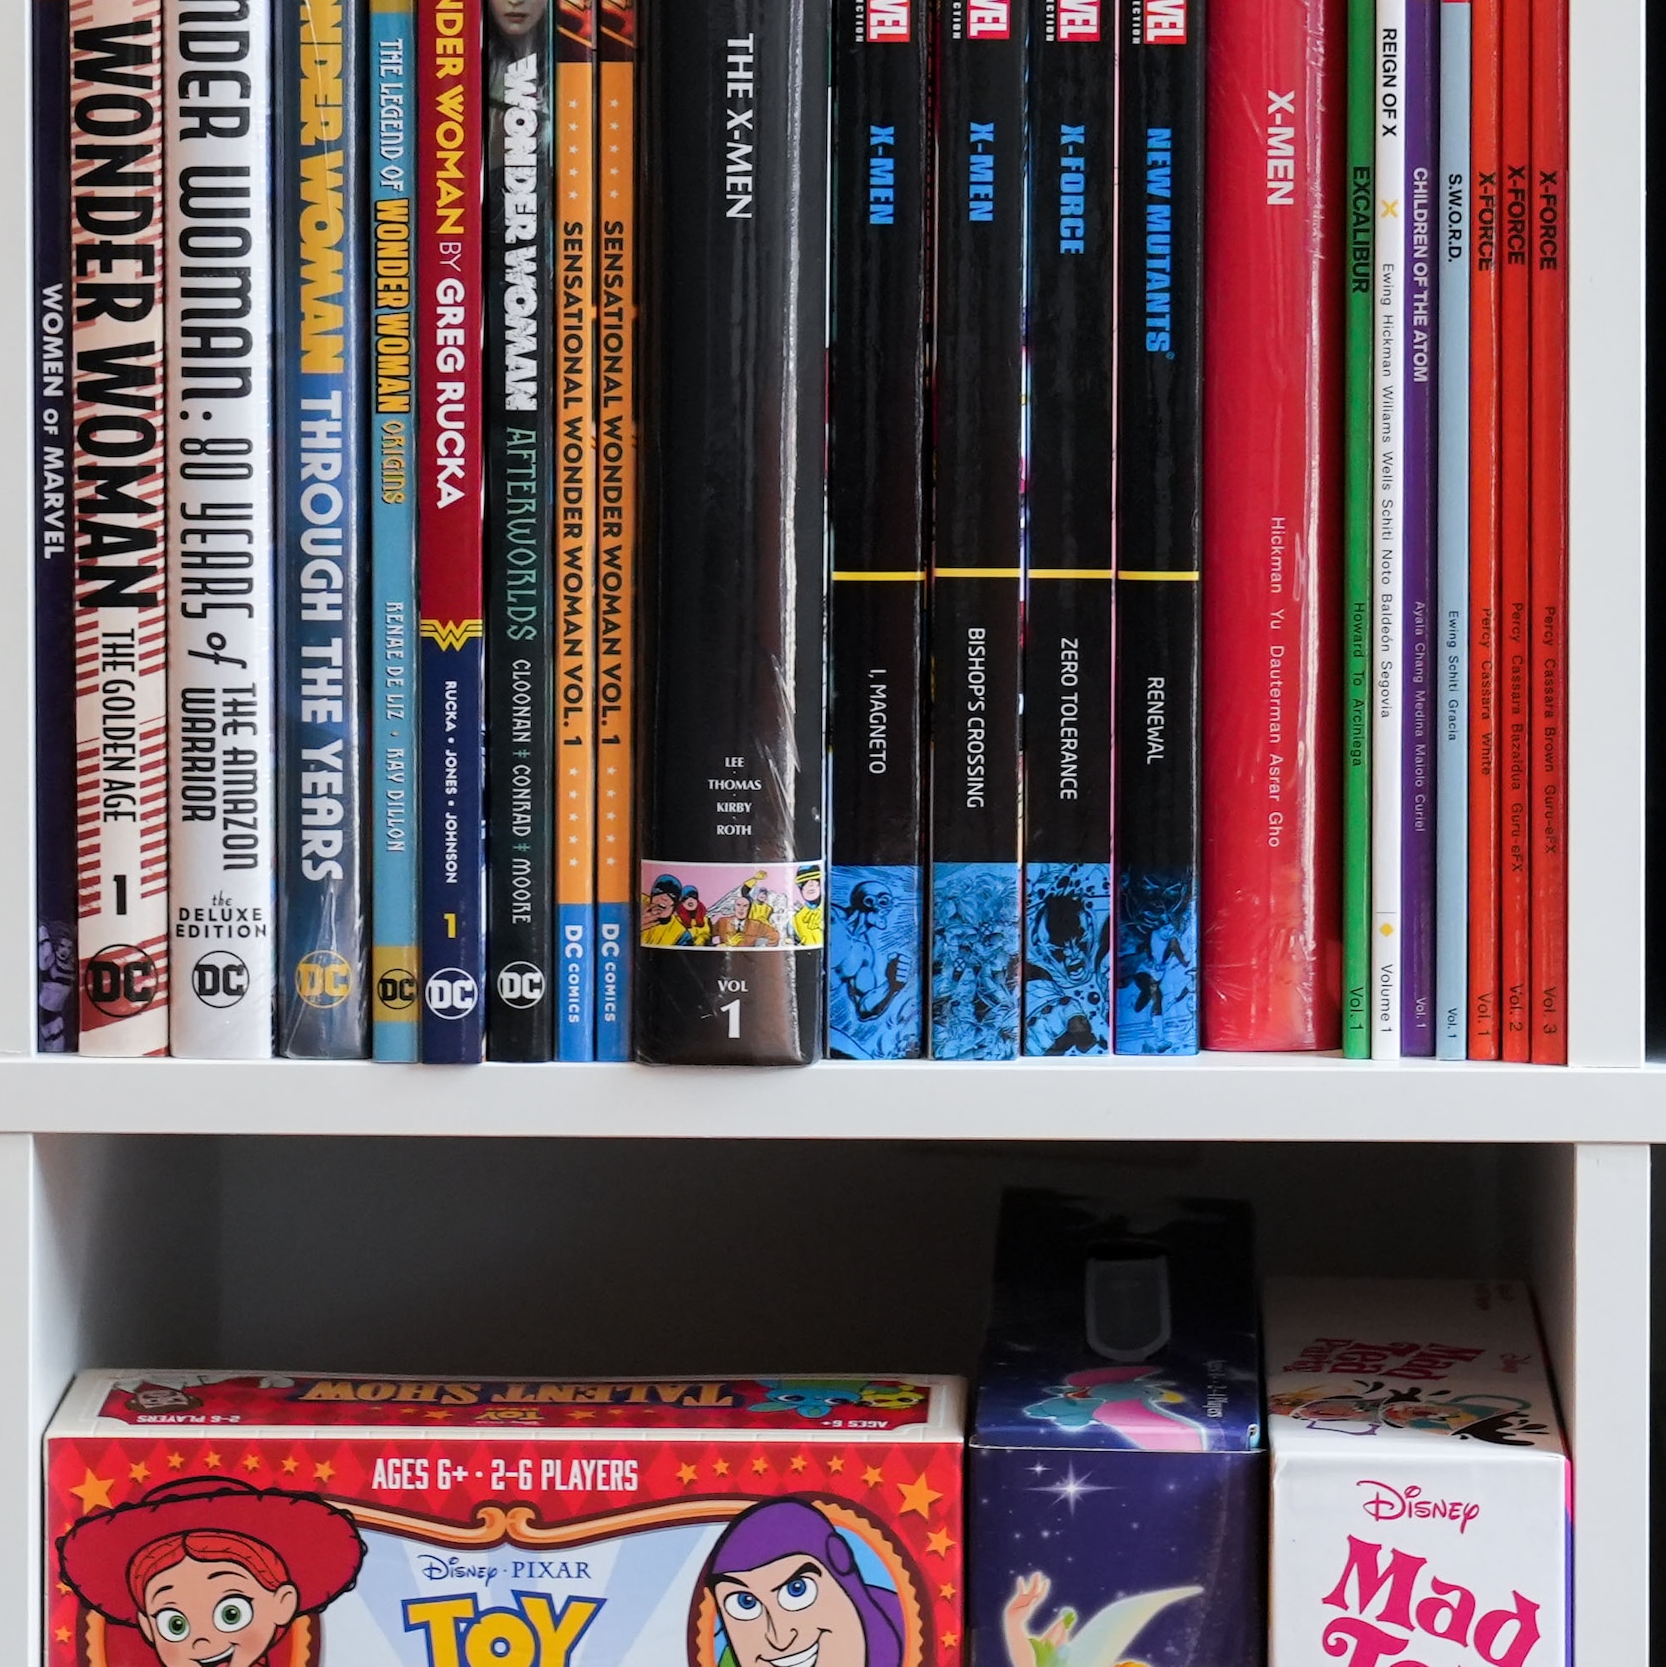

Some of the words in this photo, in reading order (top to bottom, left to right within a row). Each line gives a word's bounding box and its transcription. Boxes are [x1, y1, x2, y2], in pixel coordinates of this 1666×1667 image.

[727, 33, 753, 98] THE
[1382, 29, 1397, 87] REIGN
[1382, 93, 1397, 119] OF
[1382, 125, 1396, 136] X
[726, 109, 753, 218] X-MEN
[1267, 91, 1294, 204] X-MEN
[1448, 174, 1462, 262] S.W.O.R.D.
[564, 221, 583, 409] SENSATIONAL
[301, 390, 343, 620] THROUGH
[563, 417, 583, 538] WONDER
[1271, 518, 1285, 593] Hickman
[563, 546, 583, 656] WOMAN
[1270, 609, 1284, 630] Yu
[102, 628, 135, 672] THE
[302, 638, 343, 723] THE
[968, 628, 985, 711] BISHOP'S
[1061, 638, 1078, 686] ZERO
[102, 680, 135, 770] GOLDEN
[564, 664, 583, 727] VOL.
[1270, 646, 1284, 743] Dauterman
[564, 736, 582, 745] 1
[967, 717, 985, 807] CROSSING
[1060, 692, 1078, 799] TOLERANCE
[103, 779, 136, 822] AGE
[302, 739, 344, 880] YEARS
[1269, 754, 1283, 801] Asrar
[1269, 811, 1283, 847] Gho
[300, 1376, 469, 1404] SHOW
[477, 1376, 736, 1406] TALENT
[372, 1459, 428, 1489] AGES
[438, 1459, 468, 1489] 6+
[542, 1460, 637, 1490] PLAYERS
[512, 1561, 591, 1578] PIXAR
[1322, 1534, 1541, 1667] Mad
